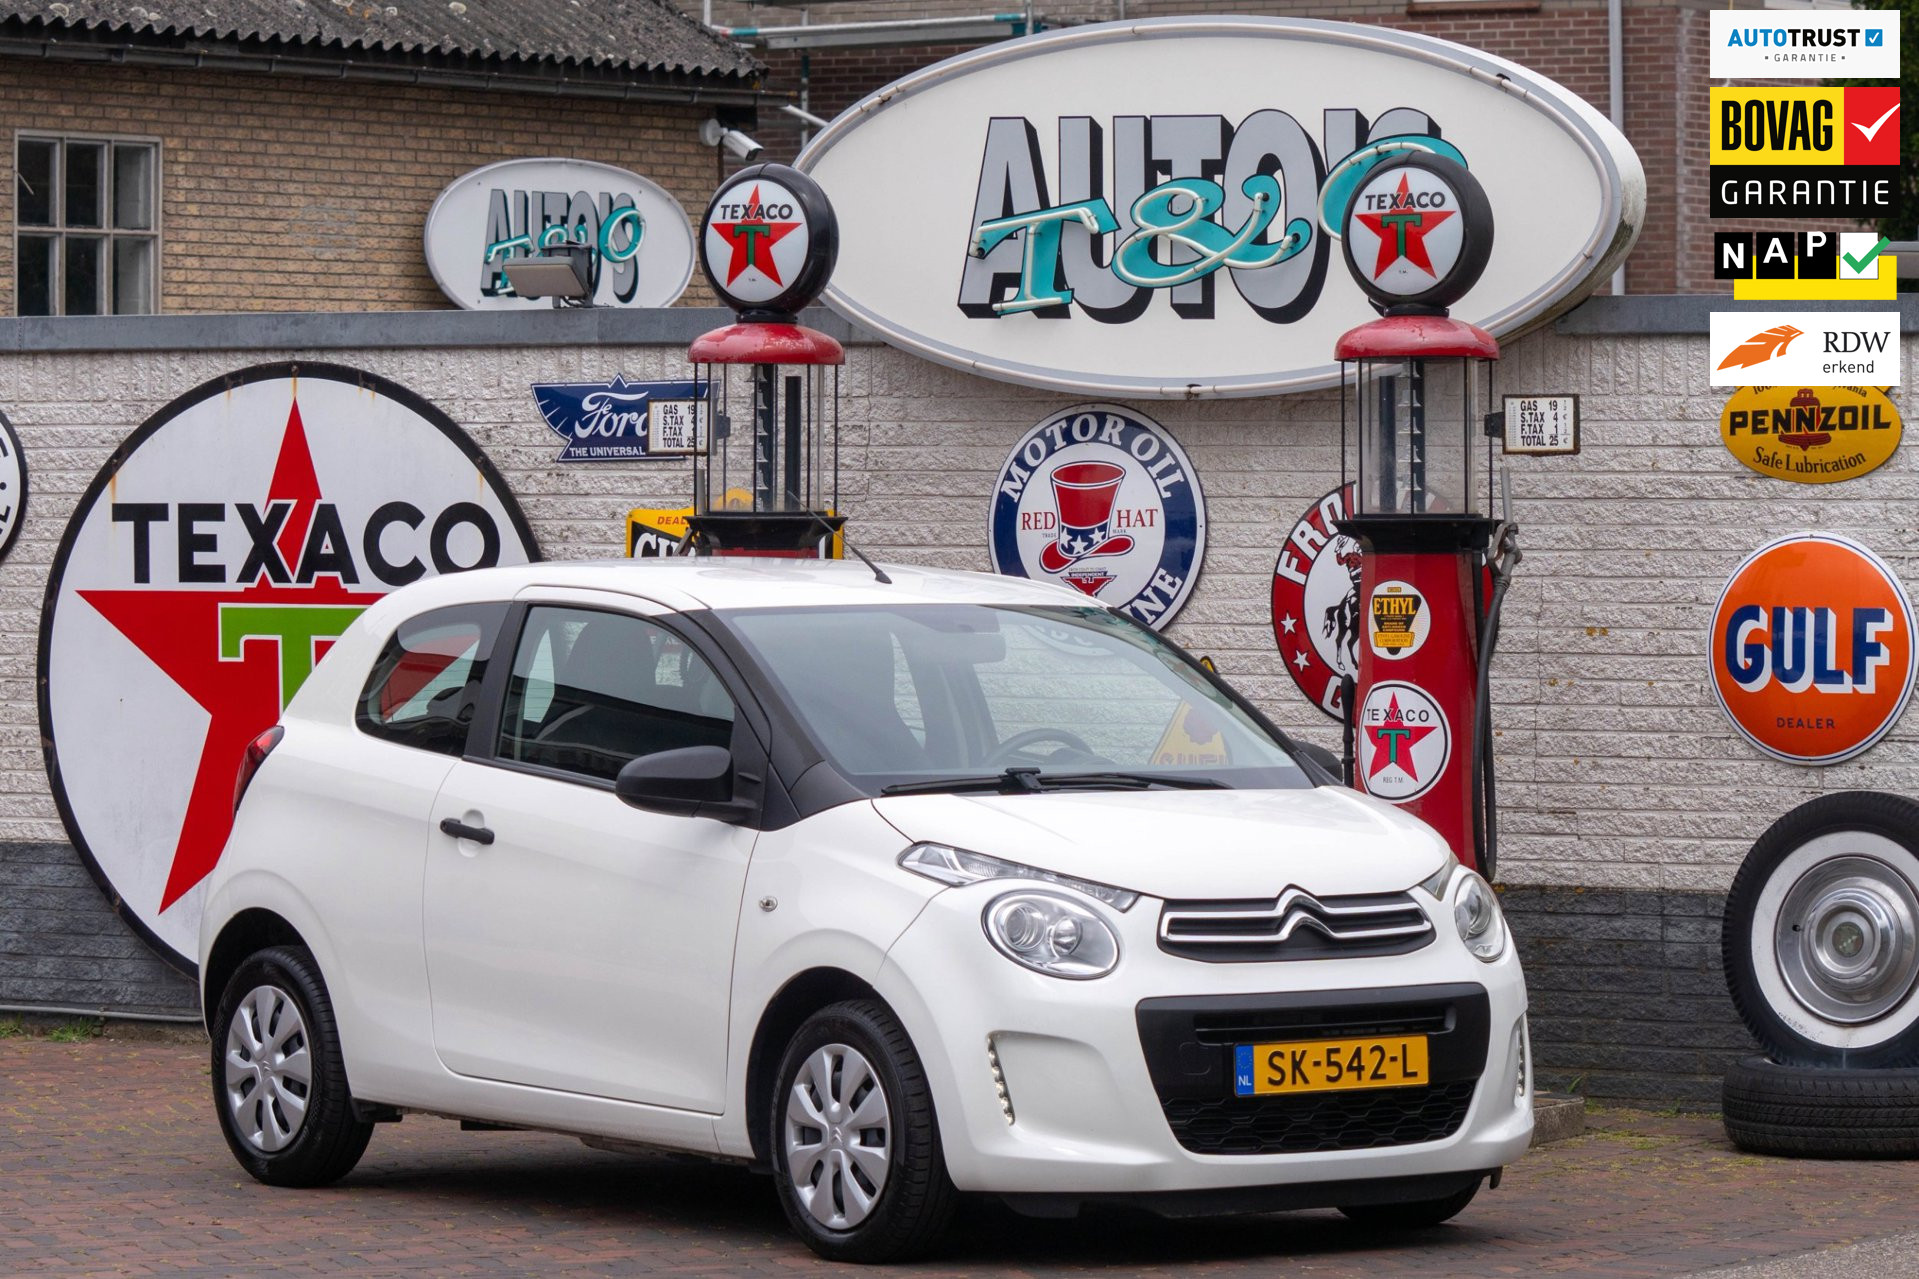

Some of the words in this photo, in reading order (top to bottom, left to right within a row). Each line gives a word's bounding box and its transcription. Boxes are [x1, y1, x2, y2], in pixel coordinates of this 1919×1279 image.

[1365, 191, 1446, 211] TEXACO
[720, 203, 793, 220] TEXACO
[1381, 213, 1422, 258] T
[733, 224, 770, 266] T
[663, 404, 679, 415] GAS
[1520, 400, 1538, 411] GAS
[1549, 400, 1558, 411] 19
[663, 415, 684, 426] S.TAX
[1520, 411, 1545, 423] S.TAX
[1553, 412, 1558, 422] 4
[1729, 404, 1892, 436] PENNZOIL
[663, 426, 683, 437] F.TAX
[1520, 423, 1544, 434] F.TAX
[663, 437, 684, 448] TOTAL
[1521, 435, 1546, 446] TOTAL
[1549, 435, 1559, 446] 25
[569, 447, 589, 458] THE
[590, 446, 646, 457] UNIVERSAL
[1000, 414, 1126, 503] MOTOR
[1130, 433, 1185, 499] OIL
[1752, 446, 1783, 470] Safe
[1785, 452, 1867, 474] Lubrication
[1021, 511, 1056, 530] RED
[1116, 508, 1158, 528] HAT
[112, 501, 501, 588] TEXACO
[1374, 597, 1417, 615] ETHYL
[1725, 604, 1893, 694] GULF
[1367, 708, 1430, 722] TEXACO
[1776, 717, 1836, 729] DEALER
[1377, 728, 1411, 763] T
[1267, 1043, 1418, 1087] SK-542-L
[1238, 1075, 1252, 1086] NL
